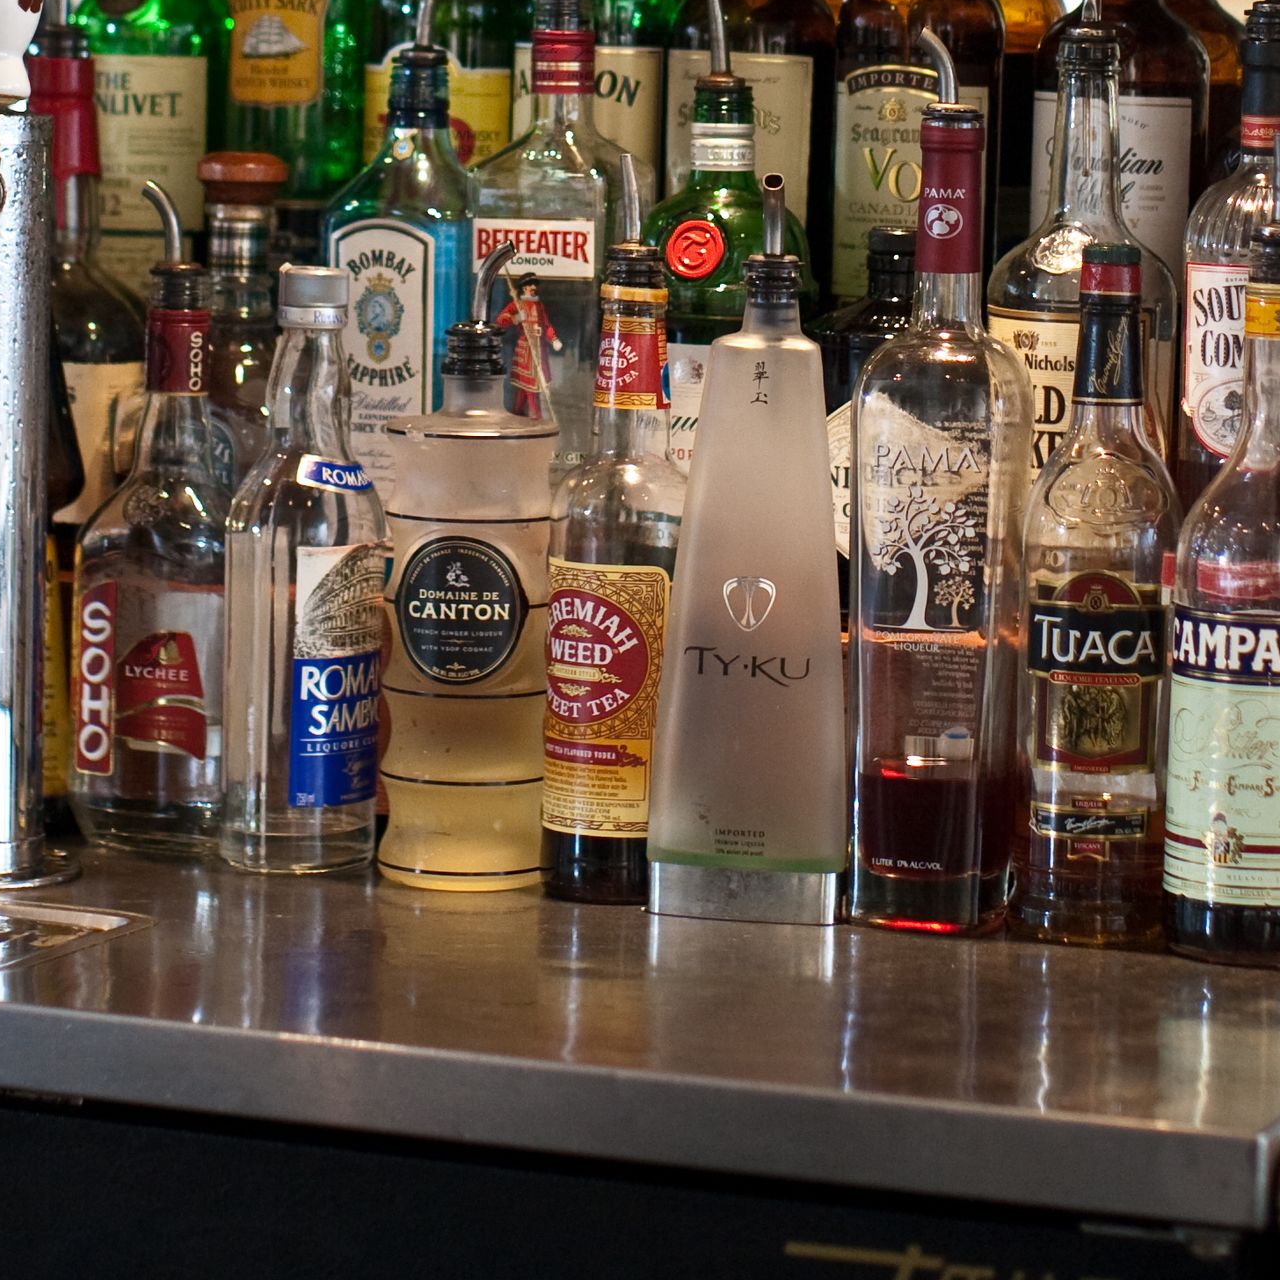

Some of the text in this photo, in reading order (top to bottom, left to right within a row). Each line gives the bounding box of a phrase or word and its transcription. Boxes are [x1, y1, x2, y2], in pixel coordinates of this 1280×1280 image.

[94, 71, 130, 91] THE
[94, 93, 183, 118] NLIVET
[862, 145, 923, 204] VO
[924, 187, 960, 200] PAMA
[476, 227, 589, 265] BEEFEATER
[346, 249, 417, 283] BOMBAY
[510, 256, 555, 266] LONDON
[188, 331, 203, 392] SOHO
[1023, 353, 1075, 373] Nichols
[617, 370, 640, 387] TEA
[350, 390, 413, 411] Distilled
[872, 444, 981, 475] PAMA
[418, 588, 500, 602] DOMAINE DE
[408, 600, 511, 621] CANTON
[440, 629, 470, 638] GINGER
[471, 630, 504, 638] LIQUEUR
[549, 596, 639, 655] EREMIAH
[875, 630, 961, 644] POMEGRANATE
[894, 641, 941, 653] LIQUEUR
[1033, 613, 1156, 666] TUACA
[420, 644, 439, 652] WITH
[462, 645, 494, 654] COGNAC
[550, 641, 614, 666] WEED
[78, 600, 113, 762] SOHO
[124, 665, 190, 682] LYCHEE
[1052, 671, 1139, 685] LIQUORE ITALIANO
[587, 687, 631, 718] TEA
[306, 740, 360, 754] LIQUORE
[594, 750, 617, 761] VODKA
[715, 828, 766, 839] IMPORTED
[875, 857, 894, 867] LITER
